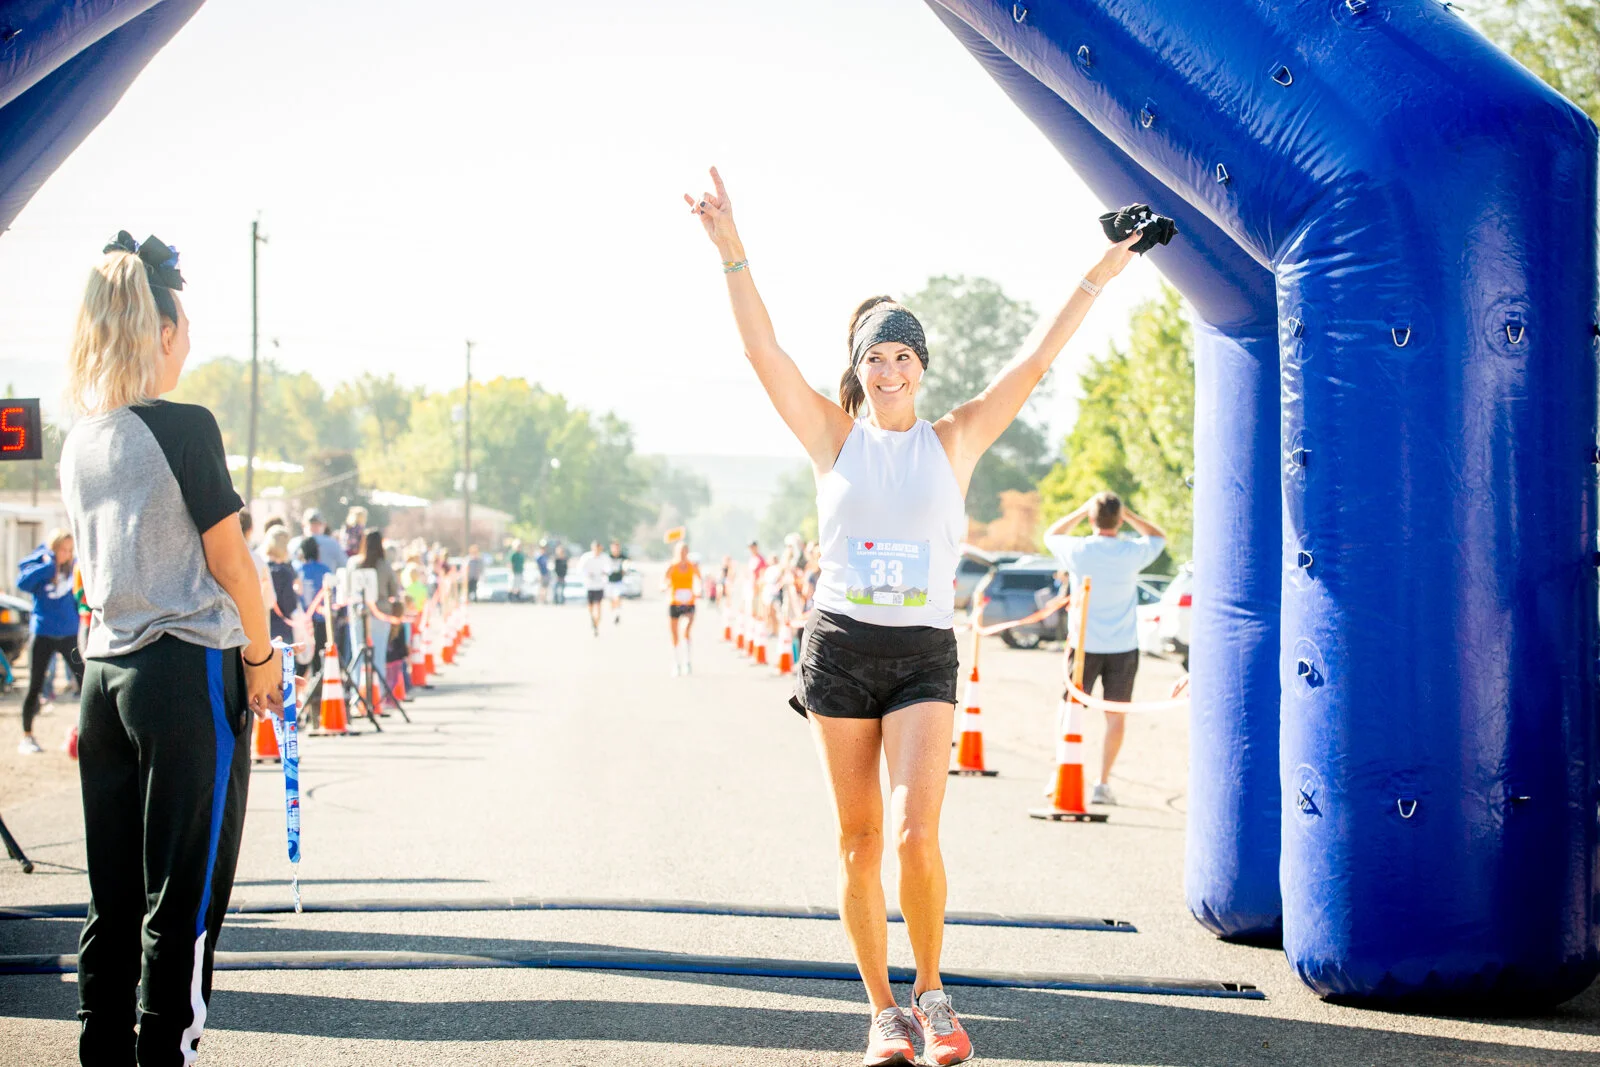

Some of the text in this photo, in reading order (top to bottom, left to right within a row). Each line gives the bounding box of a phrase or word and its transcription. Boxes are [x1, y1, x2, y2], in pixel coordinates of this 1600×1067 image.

[1, 408, 25, 450] 5
[857, 541, 862, 550] I
[870, 559, 904, 587] 33
